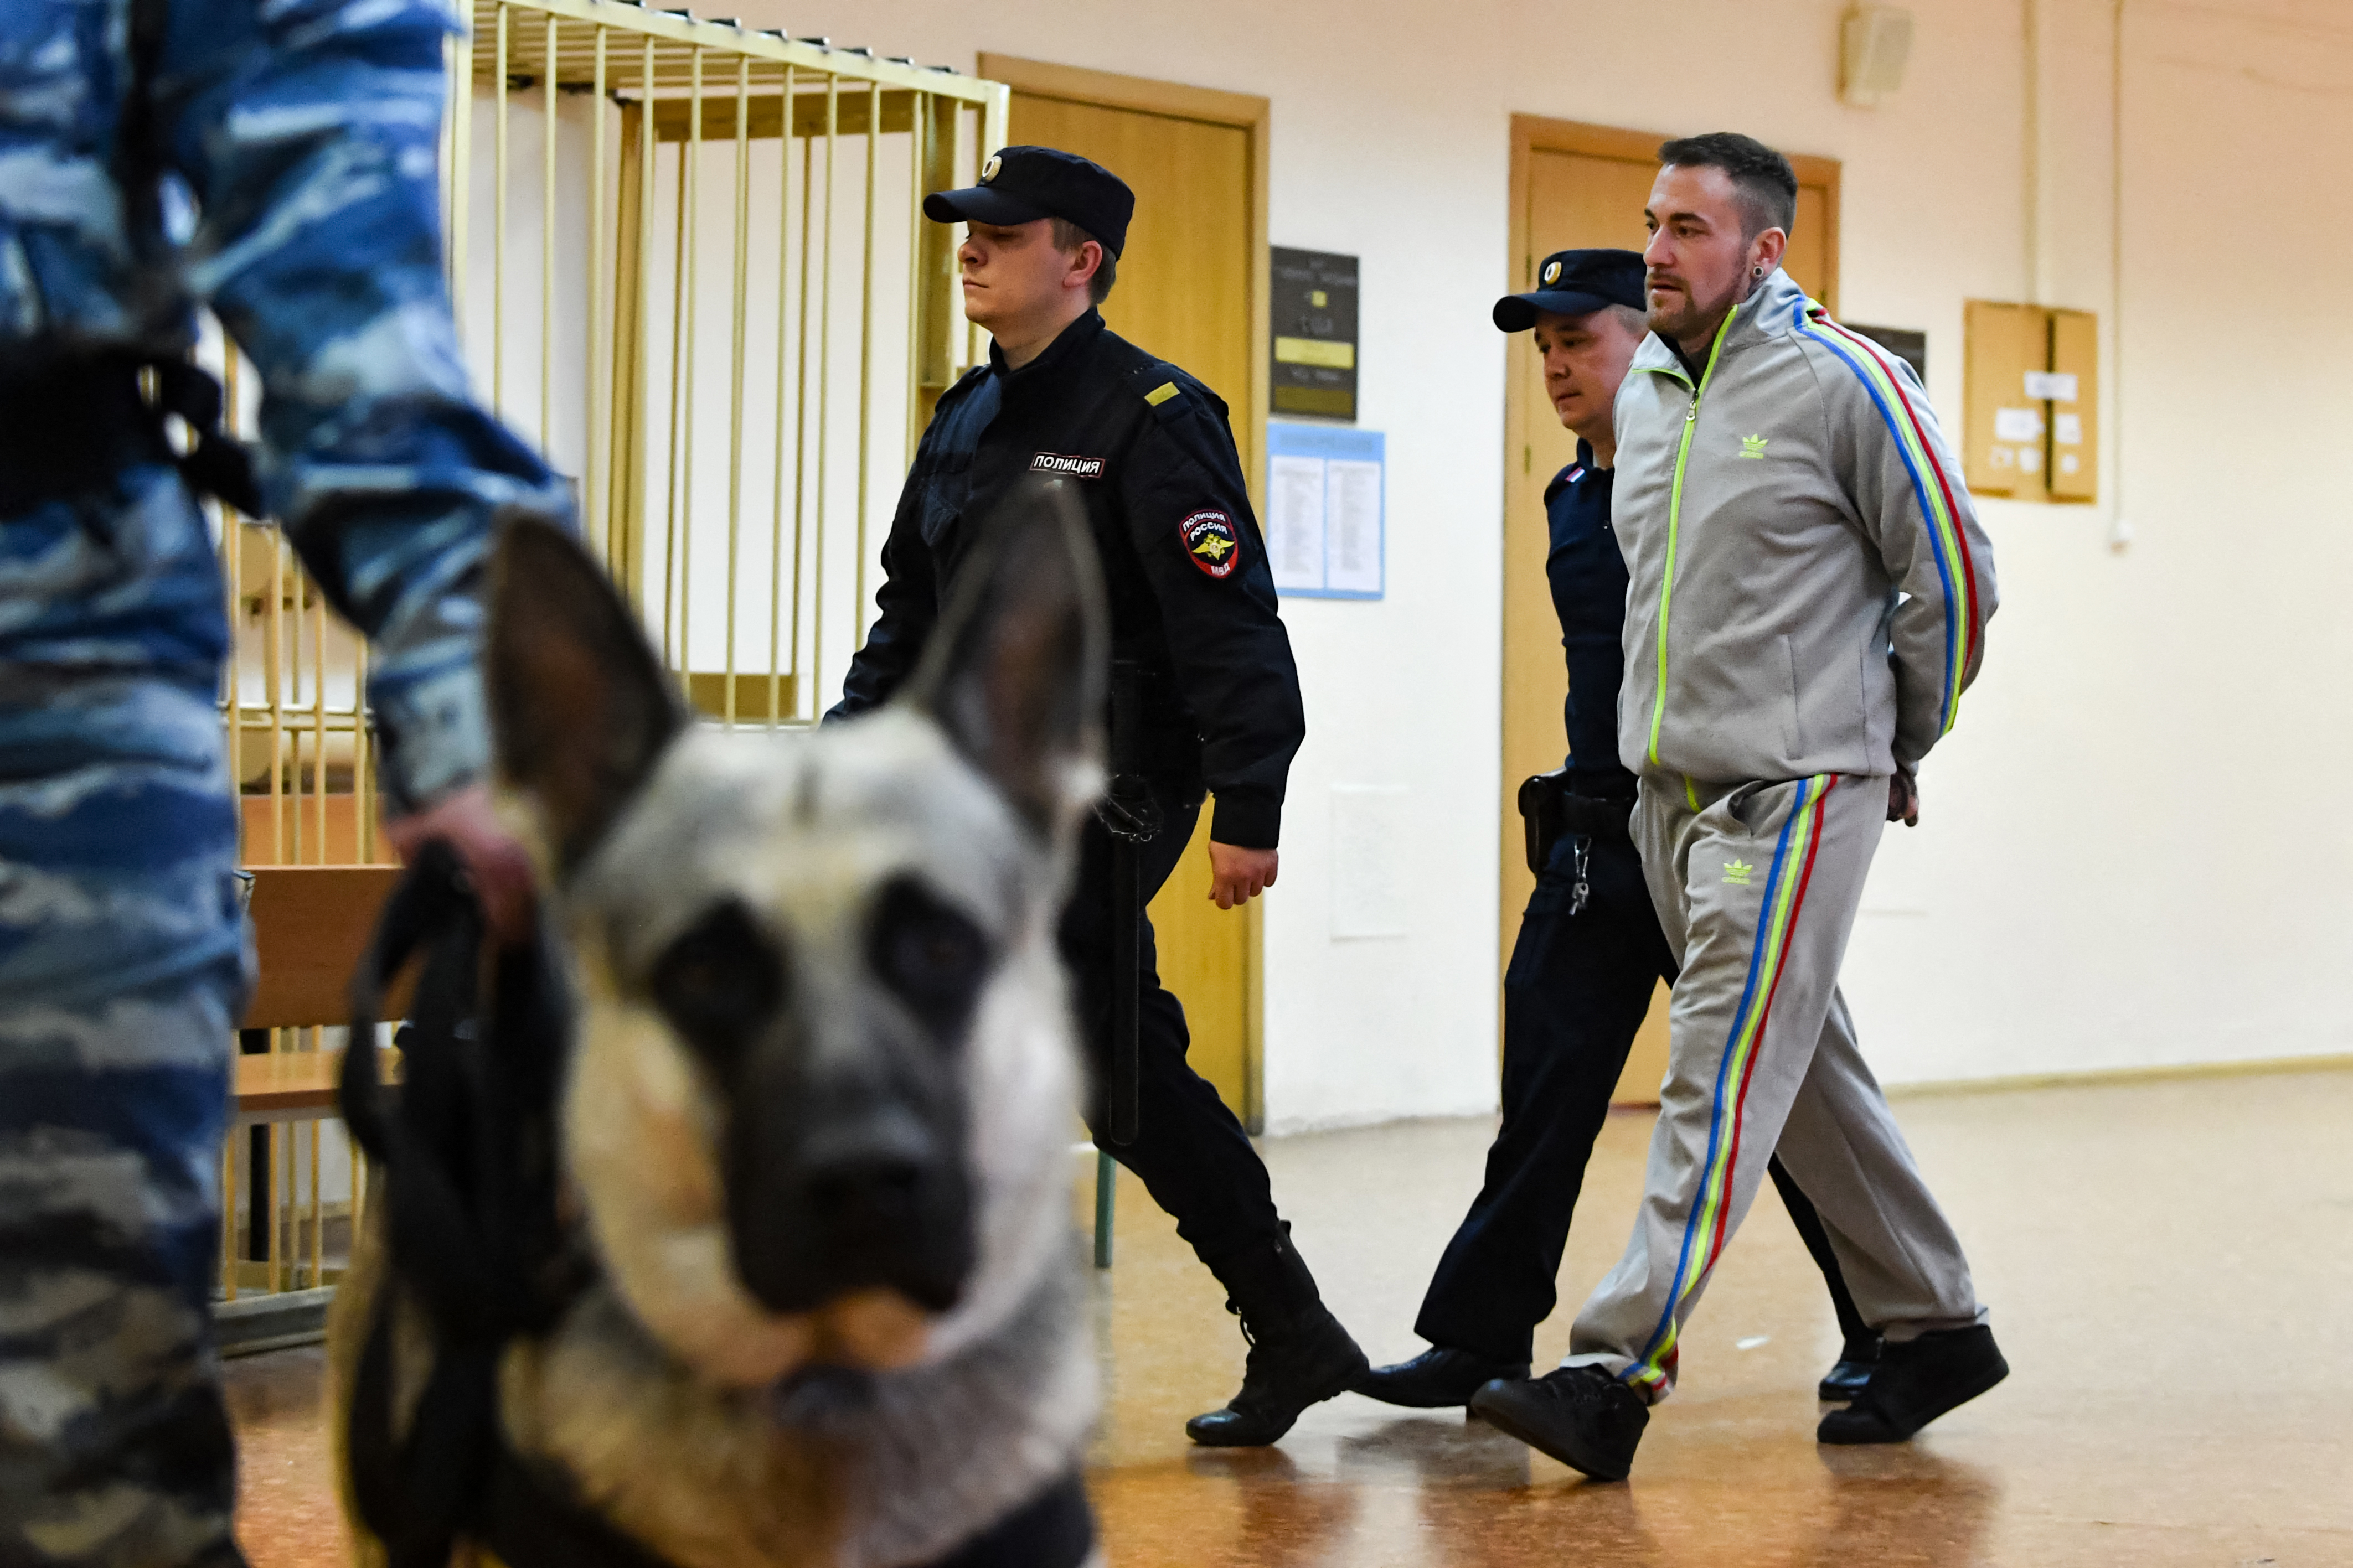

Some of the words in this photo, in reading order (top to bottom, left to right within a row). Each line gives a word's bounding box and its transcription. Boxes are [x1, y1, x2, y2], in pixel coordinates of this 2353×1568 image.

[1034, 455, 1100, 474] ПОЛИЦИЯ
[1183, 512, 1226, 532] ПОЛИЦИЯ
[1190, 522, 1227, 541] РОССИЯ
[1211, 562, 1230, 576] МВД
